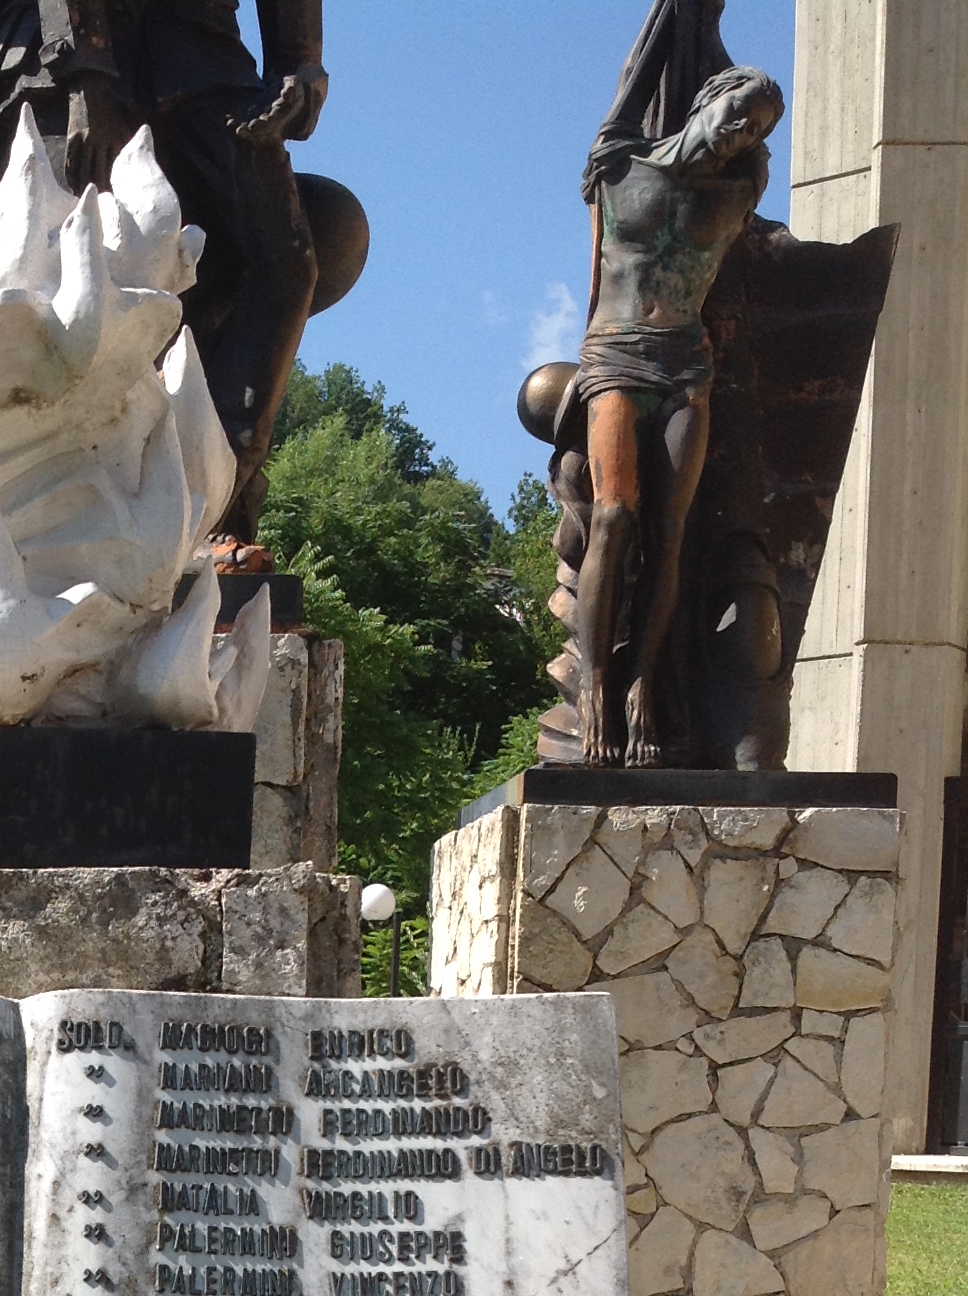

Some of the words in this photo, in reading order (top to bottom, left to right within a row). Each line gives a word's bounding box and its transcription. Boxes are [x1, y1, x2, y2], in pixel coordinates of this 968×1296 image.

[308, 1027, 413, 1060] ENRICO
[159, 1062, 273, 1093] MARIANI
[304, 1065, 464, 1098] ARCANGELO
[320, 1105, 488, 1138] FERDINANDO
[301, 1146, 458, 1179] FERDINANDO
[471, 1144, 502, 1175] DI
[507, 1141, 604, 1177] ANGELO
[158, 1180, 260, 1216] NATALIA
[300, 1188, 418, 1220] VIRGILIO
[330, 1229, 465, 1263] GIUSEPPE
